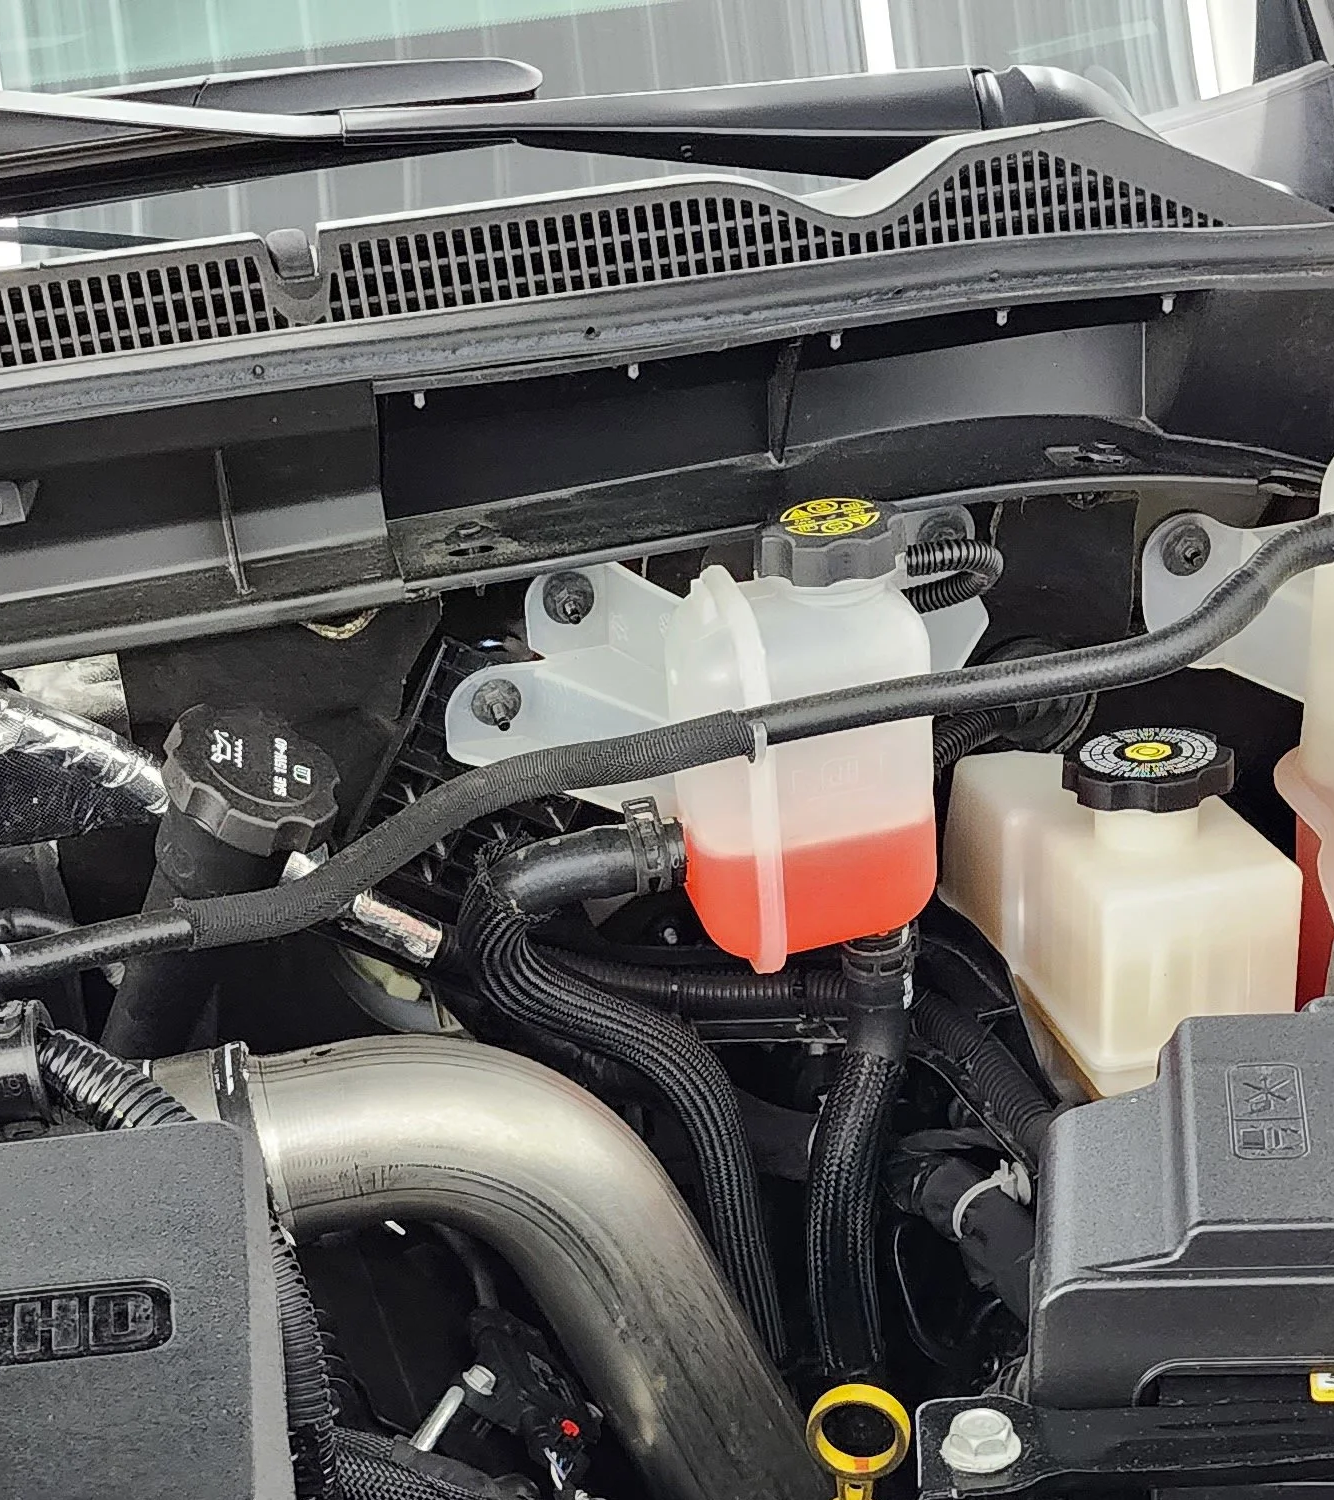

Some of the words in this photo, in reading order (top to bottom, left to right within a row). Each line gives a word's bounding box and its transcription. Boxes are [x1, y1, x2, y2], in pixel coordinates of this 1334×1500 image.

[273, 737, 289, 774] 15W-40
[272, 775, 288, 797] SAE
[12, 1287, 164, 1357] HD
